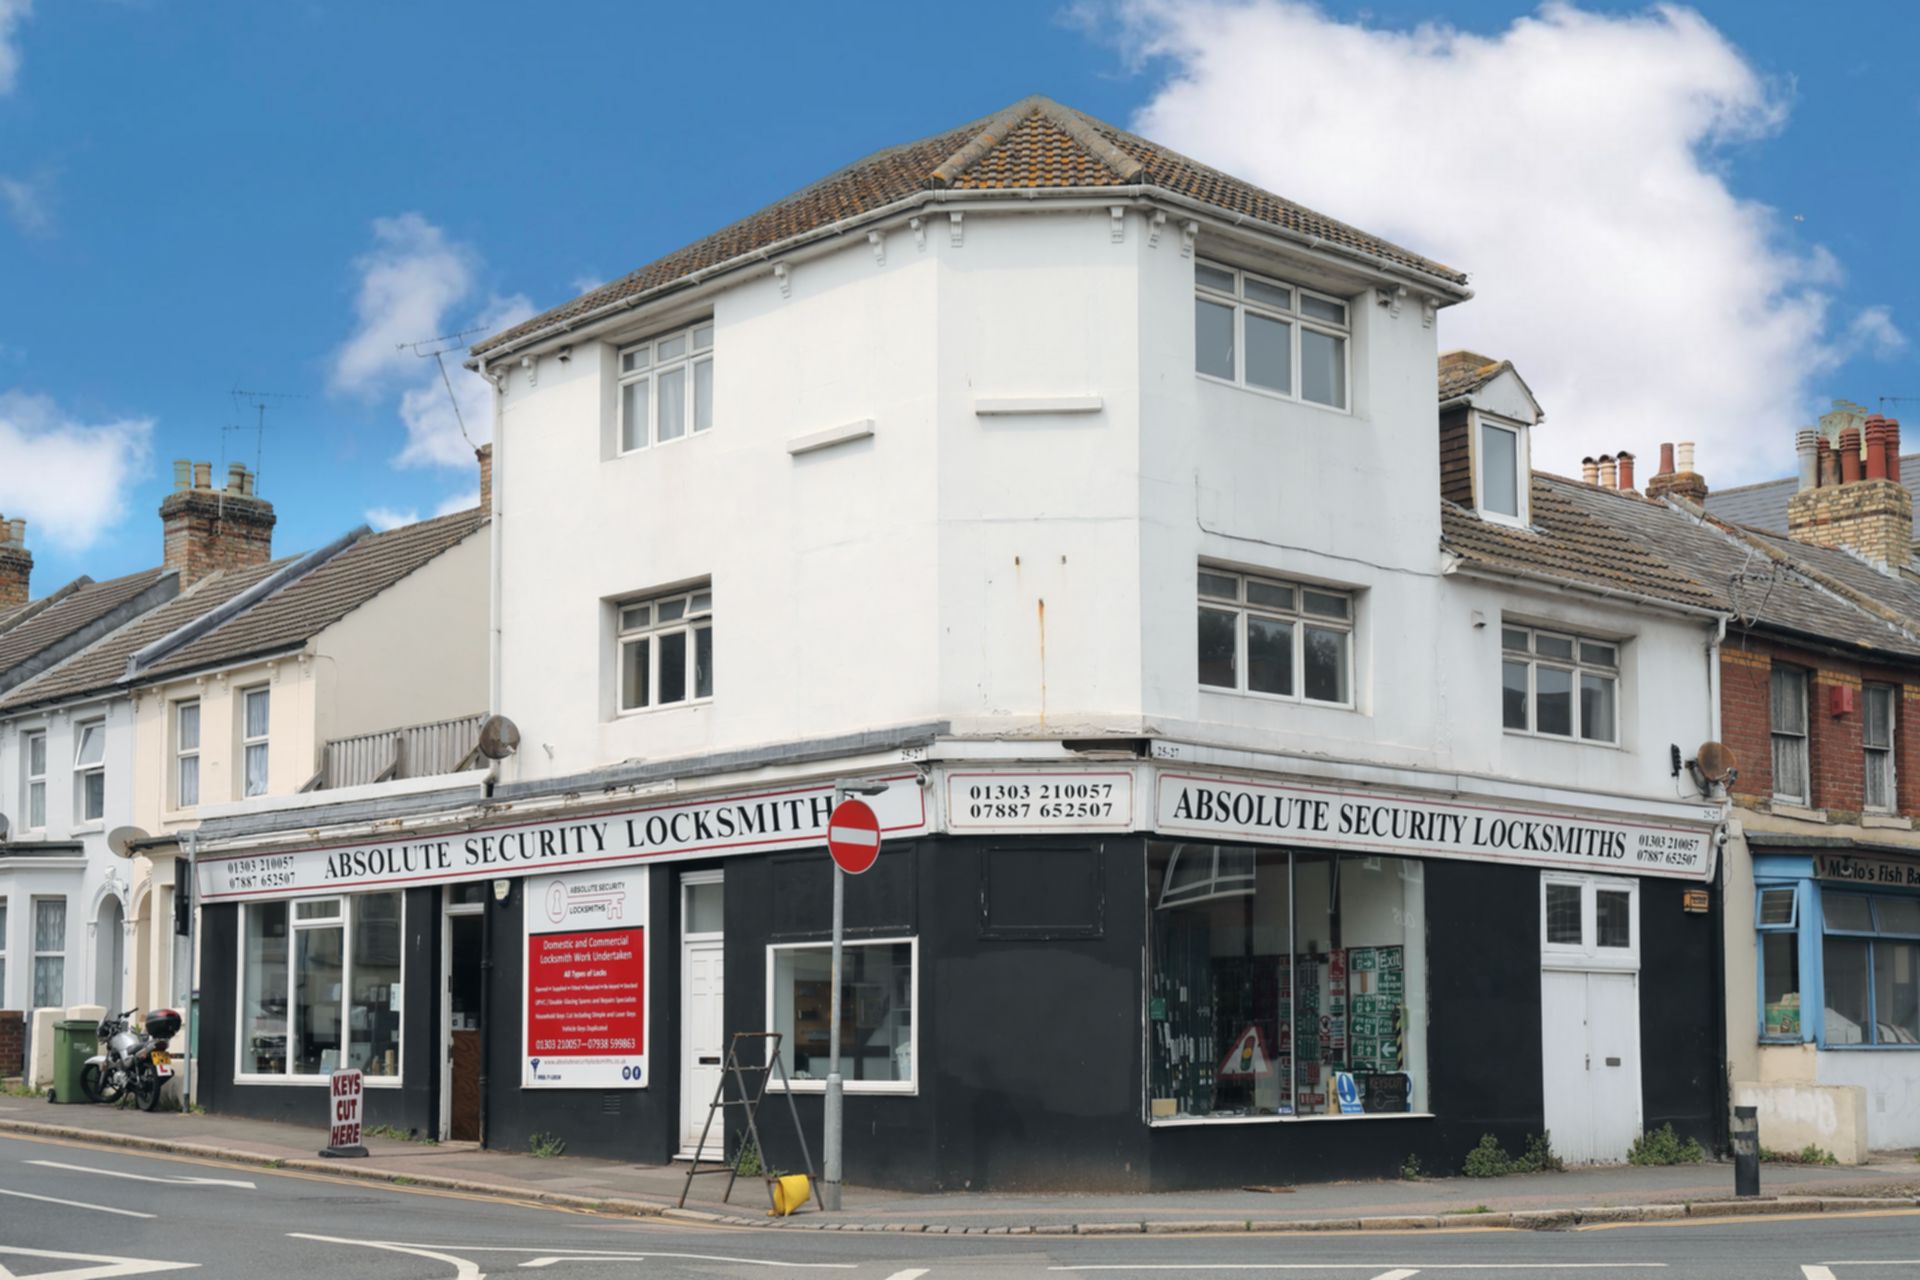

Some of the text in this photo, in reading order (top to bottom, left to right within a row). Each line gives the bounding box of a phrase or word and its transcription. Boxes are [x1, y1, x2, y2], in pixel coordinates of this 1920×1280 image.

[970, 784, 1113, 800] 01303 210057
[970, 803, 1113, 819] 07887 652507
[1173, 787, 1626, 859] ABSOLUTE SECURITY LOCKSMITHS
[324, 795, 853, 880] ABSOLUTE SECURITY LOCKSMITH
[1638, 834, 1699, 851] 01303 210057
[227, 856, 294, 874] 01303 210057
[1637, 849, 1697, 866] 07887 652507
[229, 872, 295, 889] 07887 652507
[1879, 864, 1903, 882] Fish
[570, 881, 625, 894] ABSOLUTE SECURITY
[569, 904, 606, 915] LOCKSMITHS
[543, 935, 629, 950] Domestic and Commercial
[539, 950, 633, 965] Locksmith Work Undertaken
[1379, 951, 1401, 969] Exit
[571, 970, 586, 979] Types
[535, 1039, 556, 1050] 01303
[159, 1064, 169, 1073] L
[332, 1073, 361, 1097] KEYS
[336, 1098, 358, 1122] CUT
[331, 1122, 360, 1147] HERE
